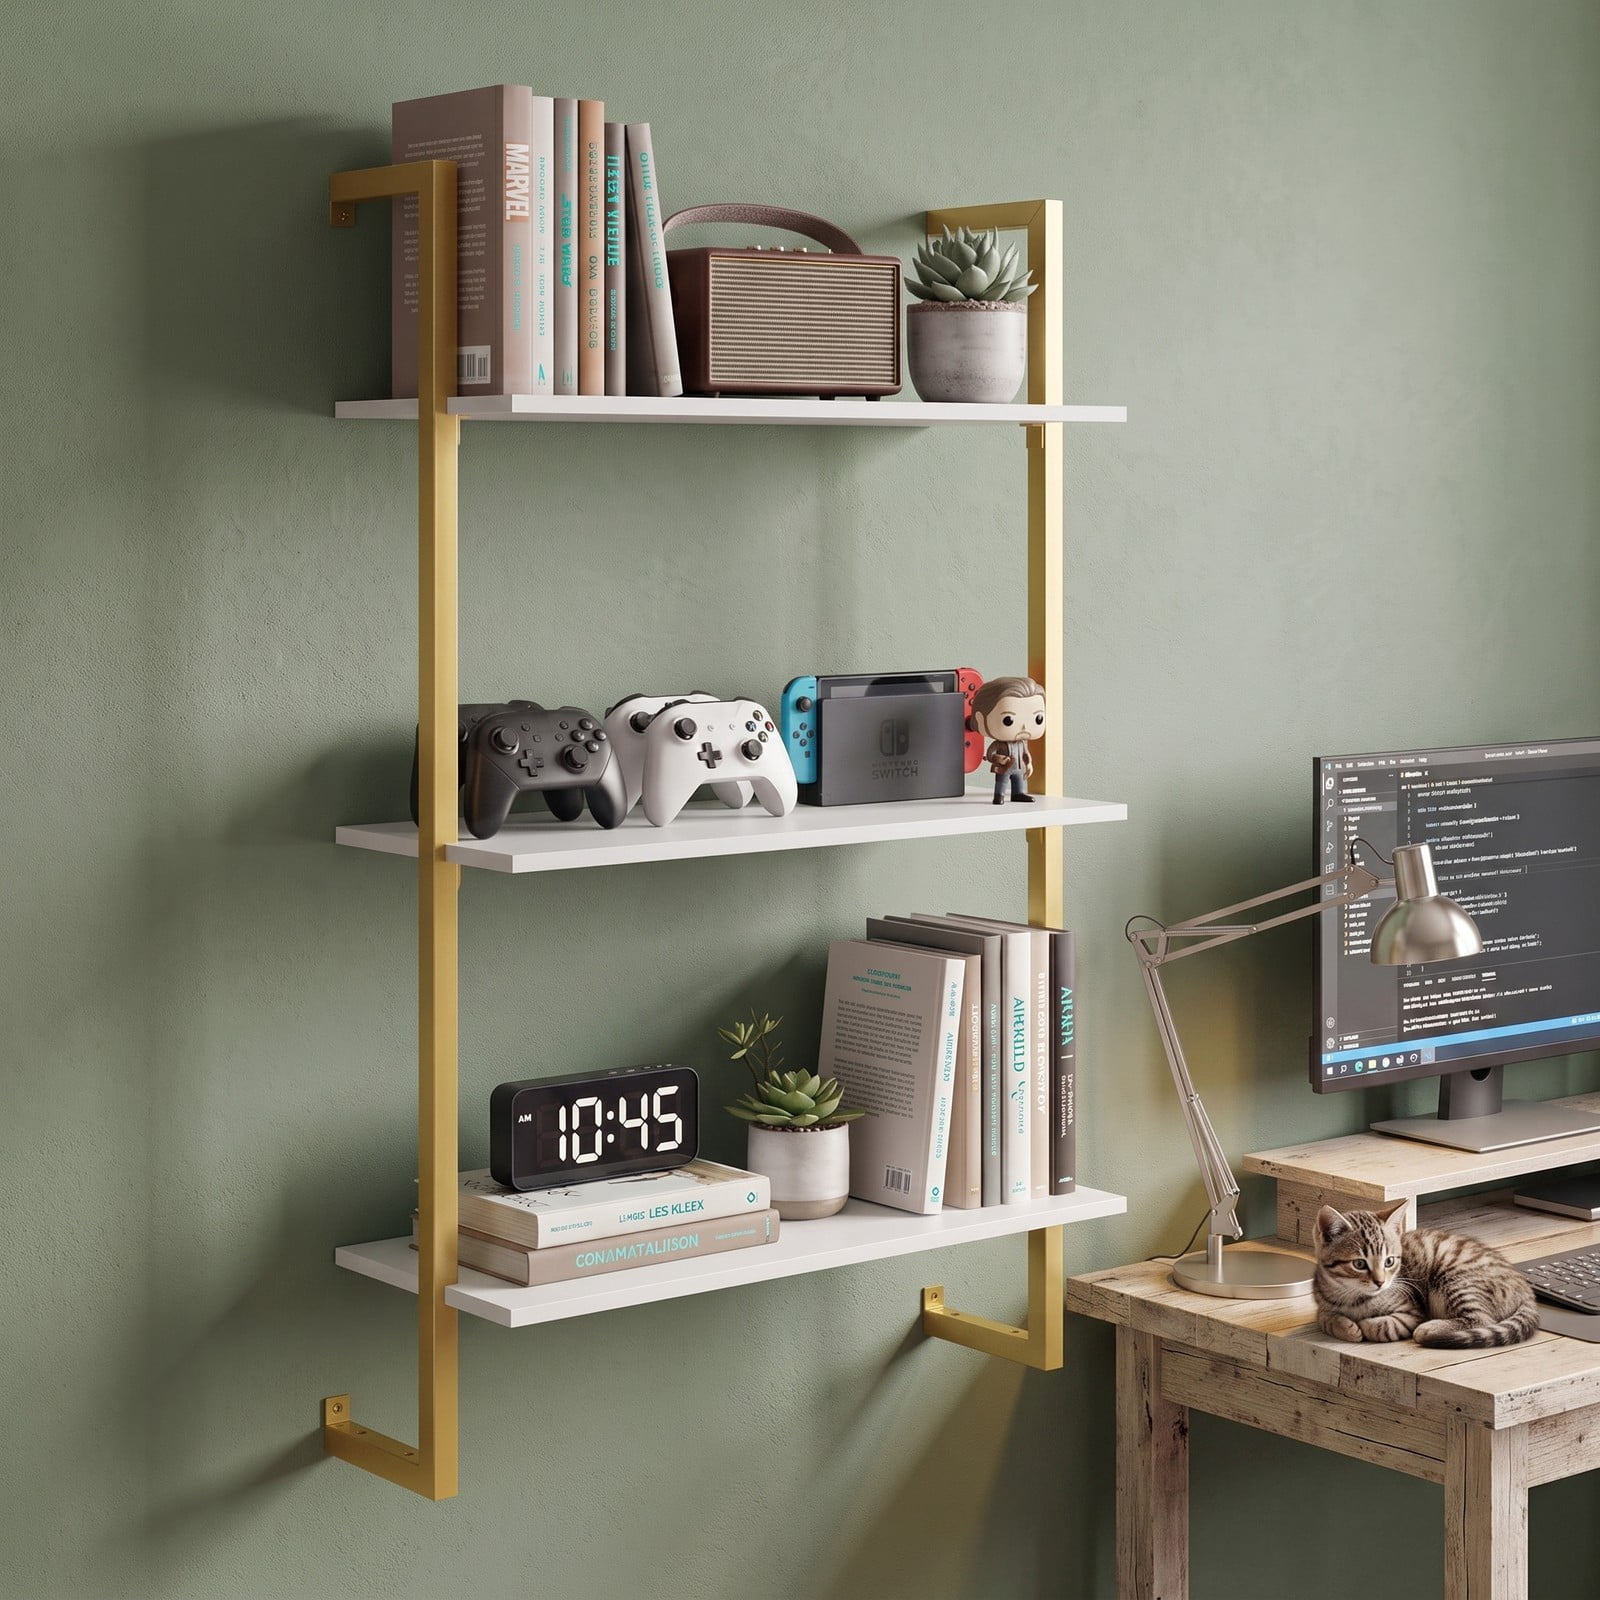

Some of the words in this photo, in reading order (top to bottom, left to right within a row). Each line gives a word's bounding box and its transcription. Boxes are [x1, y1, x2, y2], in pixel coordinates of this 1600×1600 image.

[505, 143, 530, 221] MARVEL
[872, 767, 919, 780] SWITCH
[518, 1113, 532, 1124] AM
[559, 1085, 683, 1164] 10:45
[649, 1205, 669, 1219] LES
[671, 1200, 705, 1214] KLEEX
